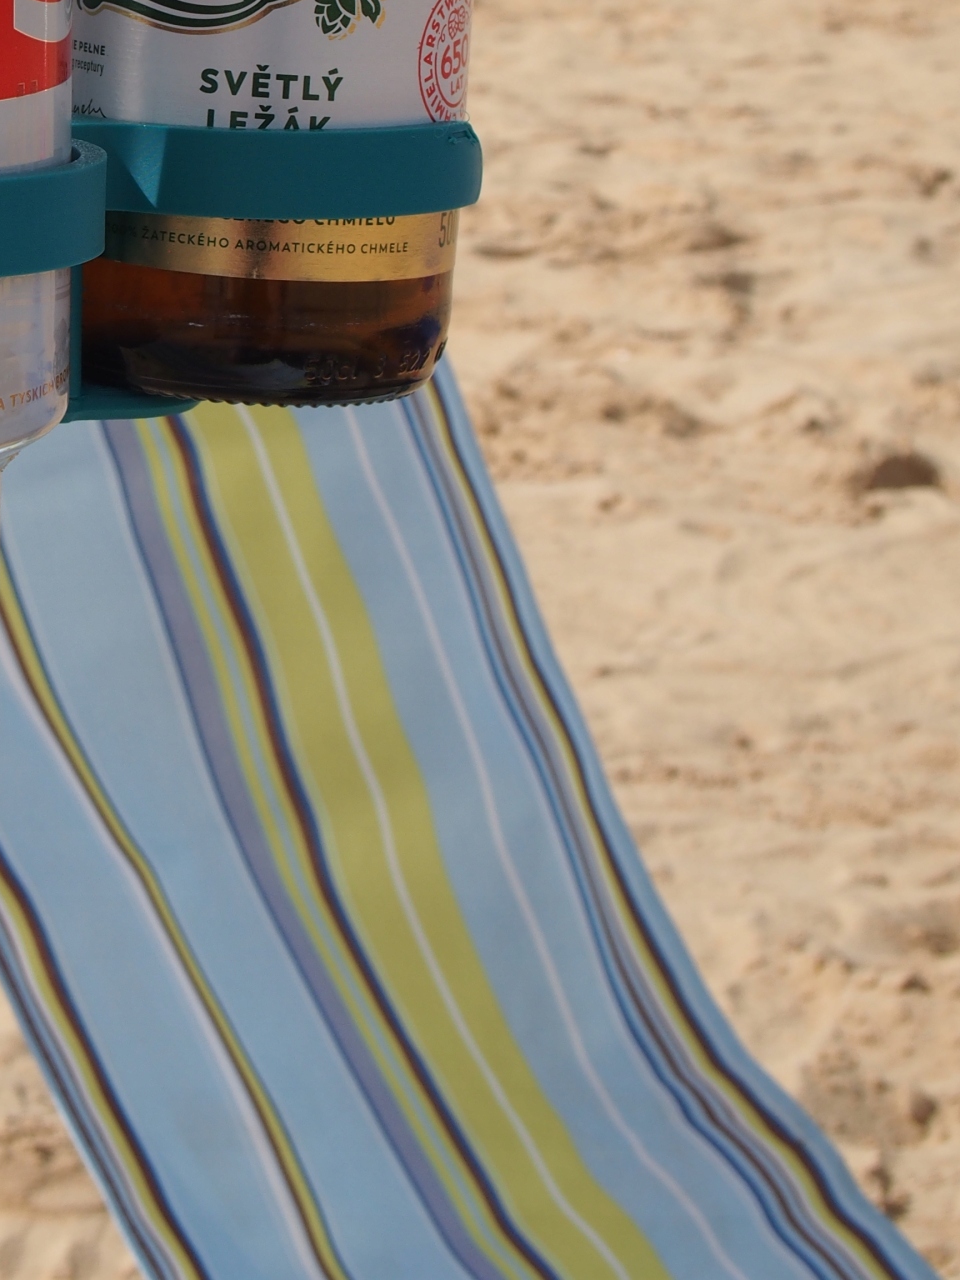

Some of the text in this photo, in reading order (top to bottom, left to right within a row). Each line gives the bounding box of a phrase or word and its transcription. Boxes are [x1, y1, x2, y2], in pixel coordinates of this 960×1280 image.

[78, 41, 106, 56] PEŁNE
[441, 33, 469, 80] 650
[74, 59, 105, 77] receptury
[199, 64, 345, 102] SVĚTLÝ
[450, 74, 465, 96] LAT
[142, 226, 229, 248] ŽATECKÉHO
[234, 239, 356, 254] AROMATICKÉHO
[360, 241, 409, 254] CHMELE
[9, 379, 55, 408] TYSKICH
